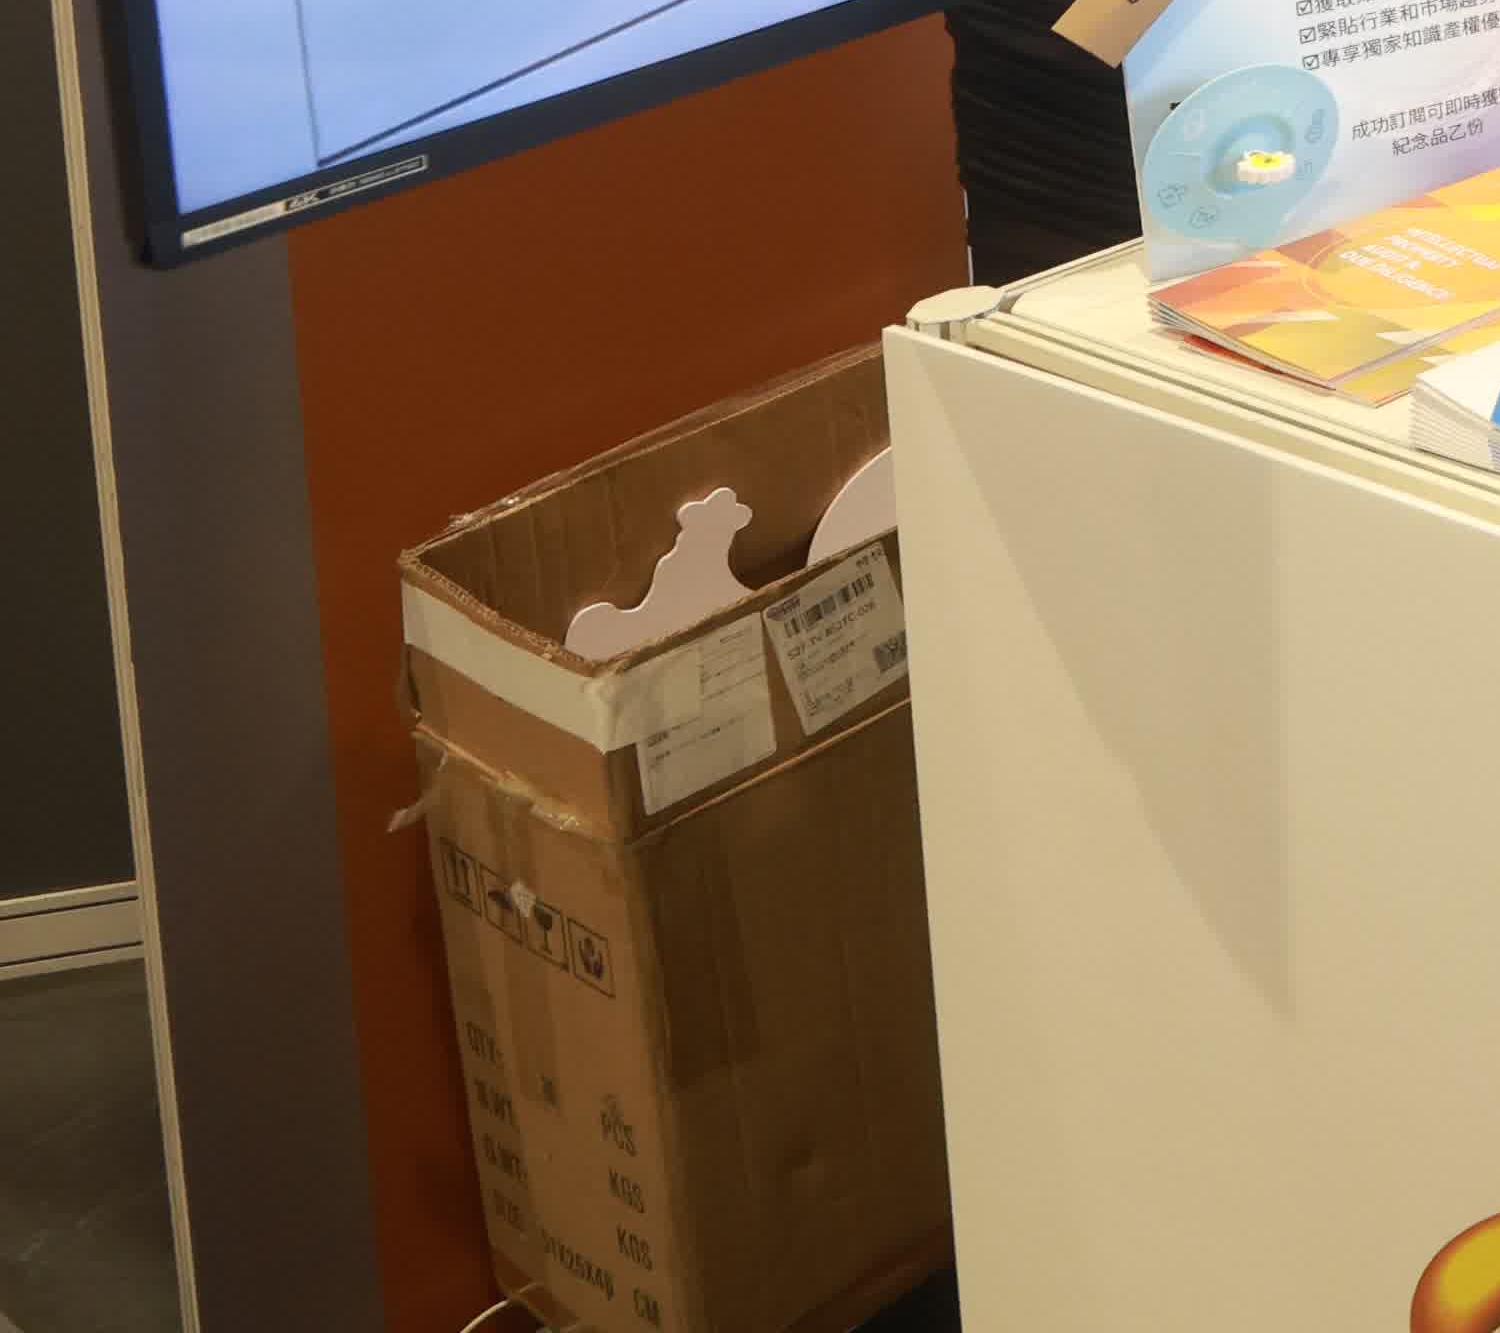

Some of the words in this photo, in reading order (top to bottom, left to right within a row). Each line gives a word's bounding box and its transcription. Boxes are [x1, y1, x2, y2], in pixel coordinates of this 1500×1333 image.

[1391, 116, 1485, 158] 紀念品乙份
[608, 1166, 646, 1214] KGS
[616, 1224, 654, 1272] KGS
[633, 1288, 661, 1329] CM
